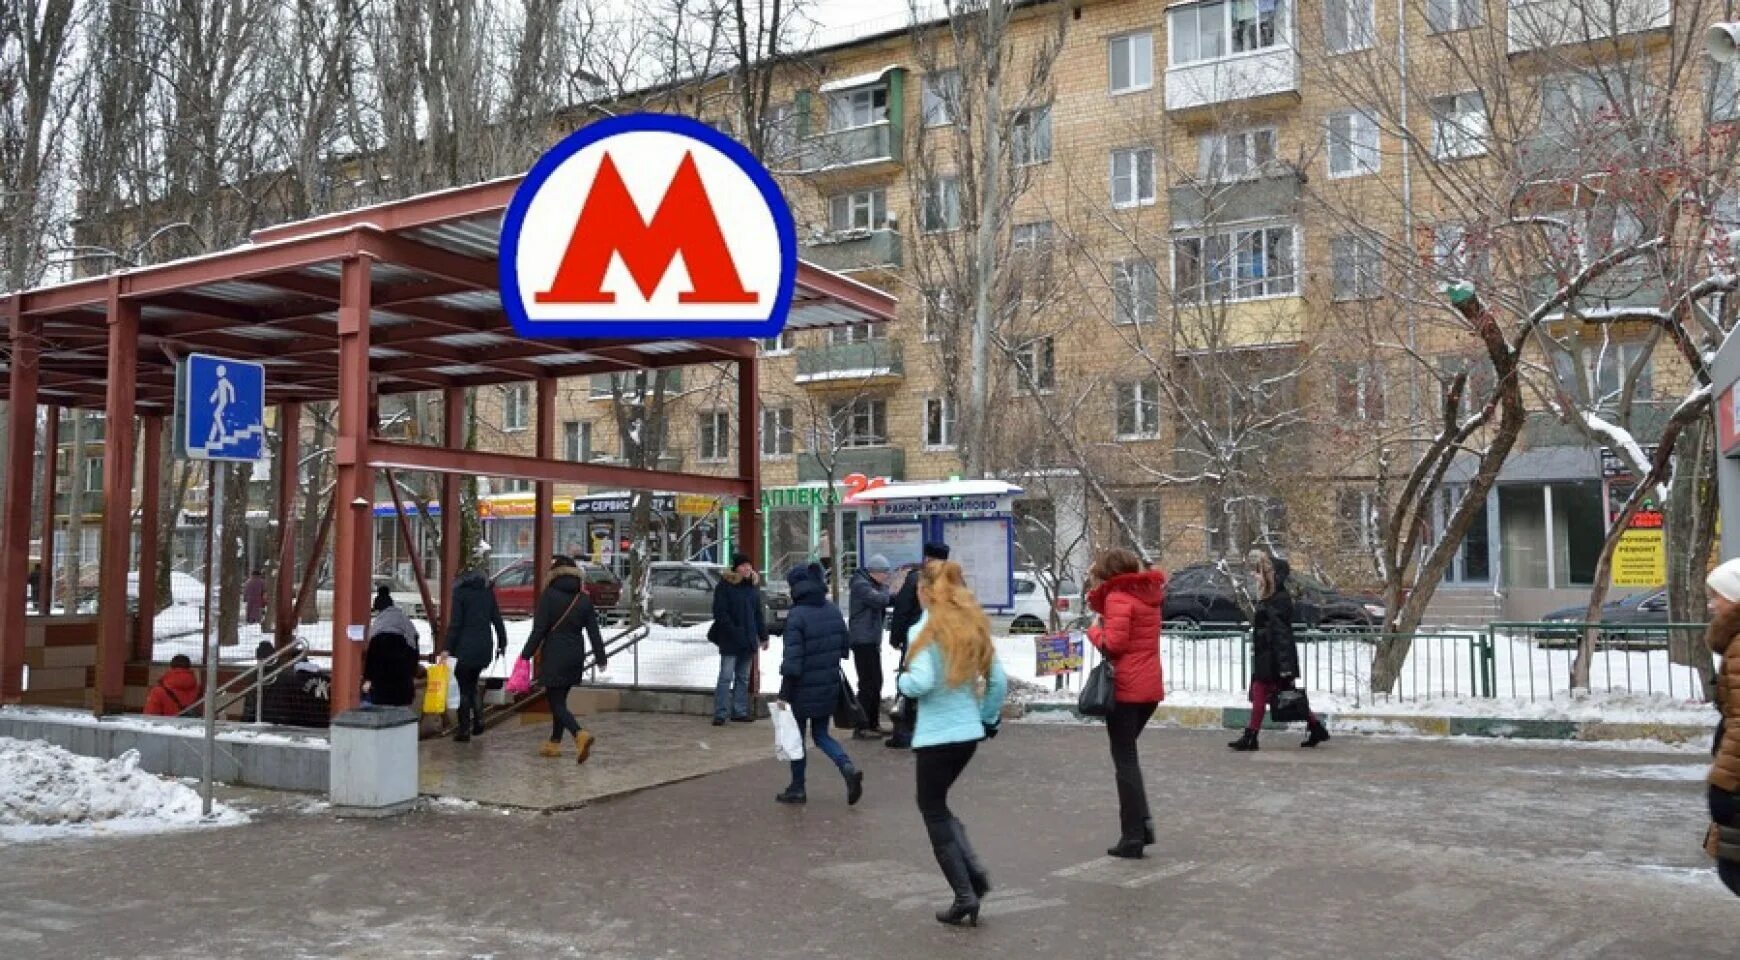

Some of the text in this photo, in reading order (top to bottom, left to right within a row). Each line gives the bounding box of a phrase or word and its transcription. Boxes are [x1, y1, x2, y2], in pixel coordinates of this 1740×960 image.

[760, 487, 841, 507] АПТЕКА
[591, 499, 630, 512] СЕРВИС
[885, 500, 997, 514] РАЙОН ИЗМАЙЛОВО
